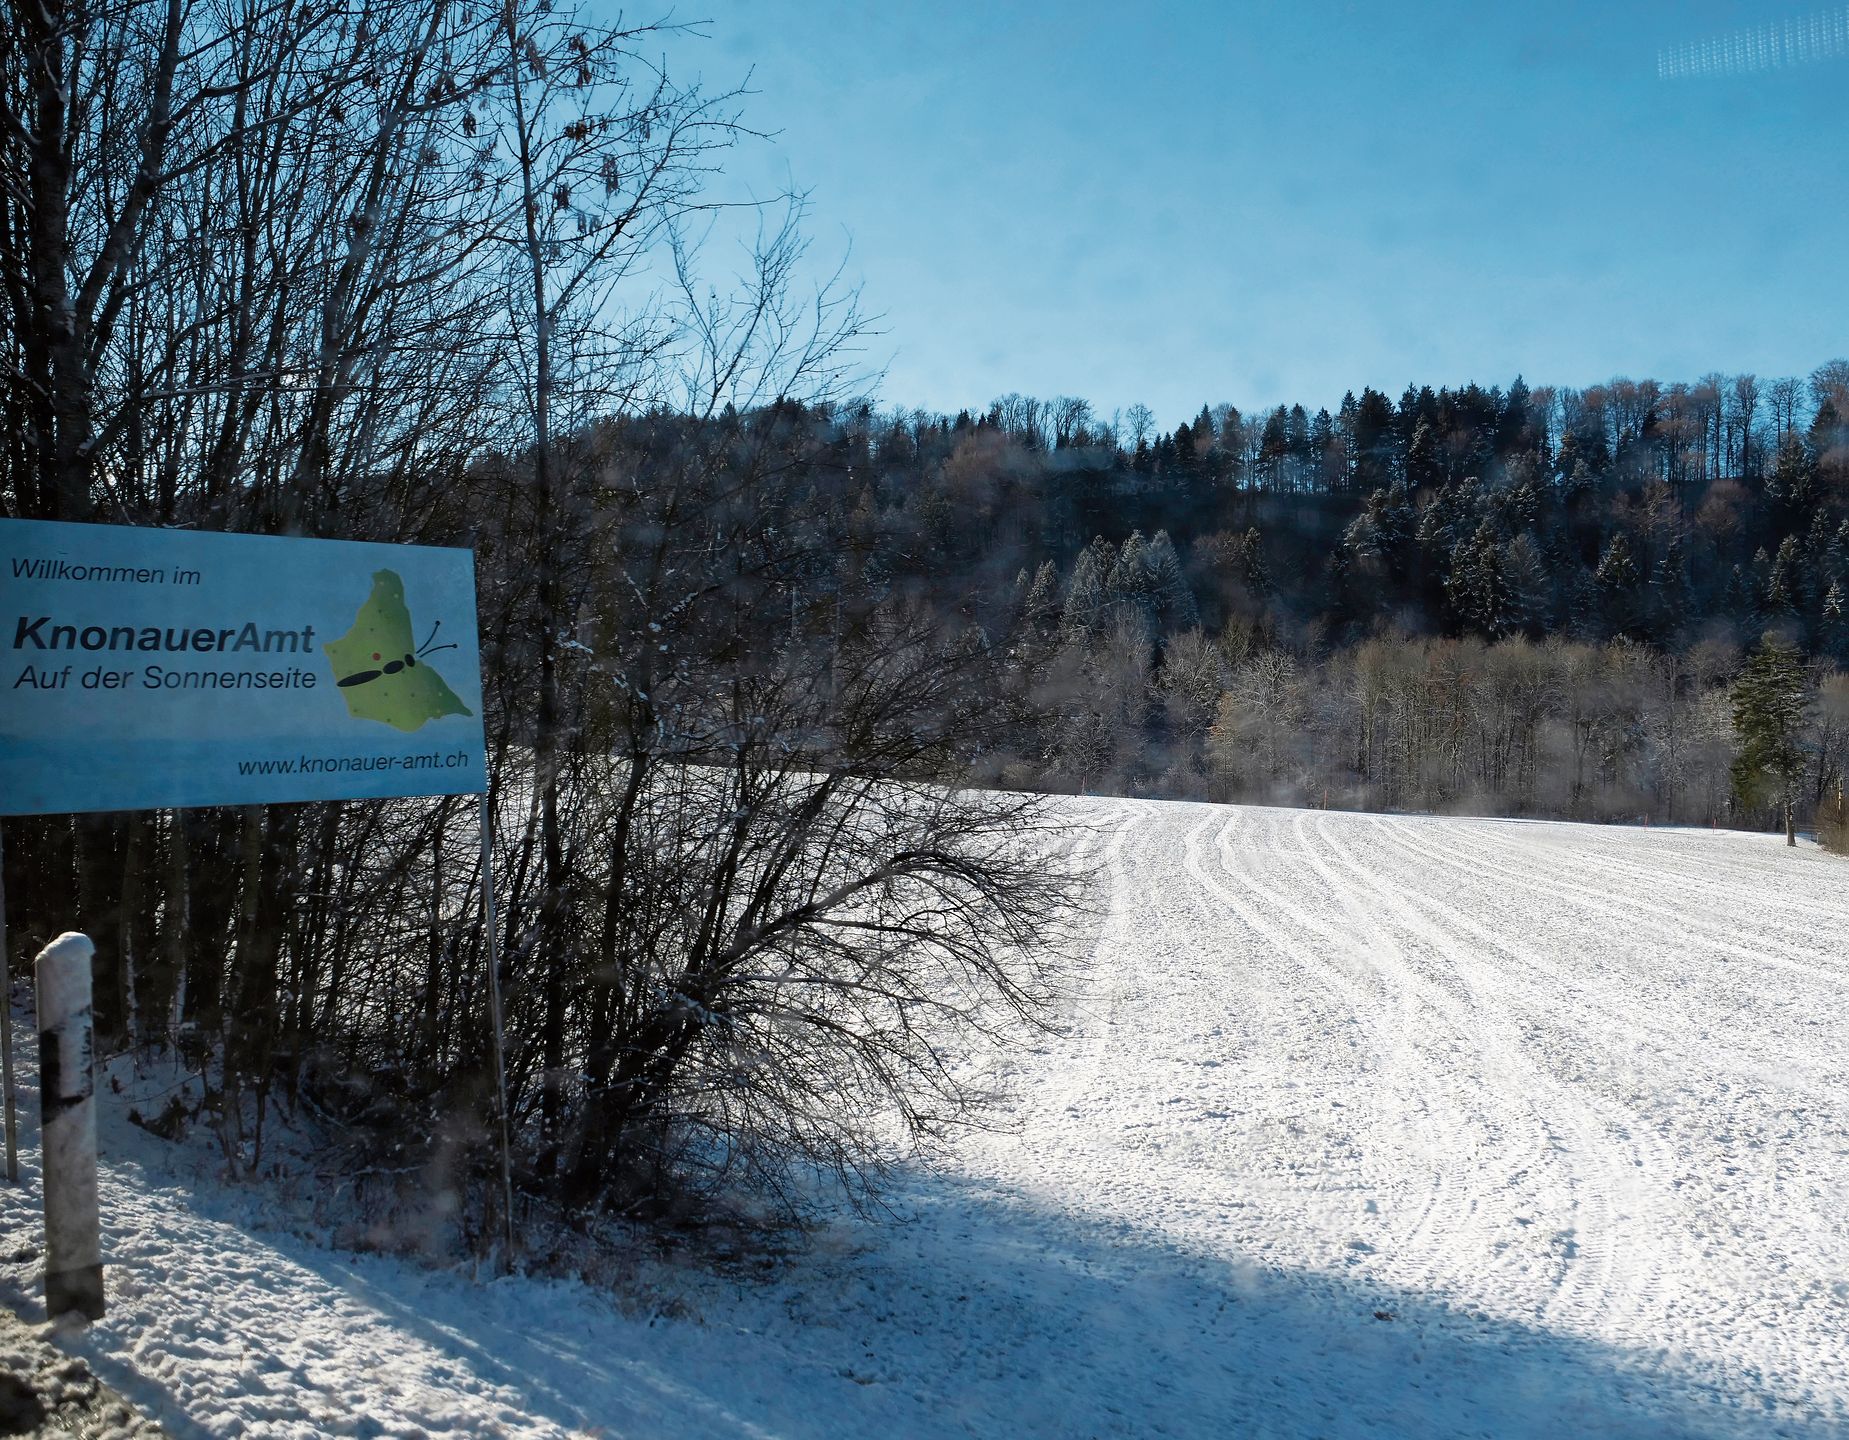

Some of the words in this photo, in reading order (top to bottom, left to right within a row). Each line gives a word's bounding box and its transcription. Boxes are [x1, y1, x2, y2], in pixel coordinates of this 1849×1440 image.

[12, 557, 164, 584] Willkommen
[173, 565, 201, 585] im
[13, 616, 315, 653] KnonauerAmt
[13, 664, 73, 689] Auf
[81, 665, 134, 690] der
[143, 664, 316, 689] Sonnenseite
[238, 750, 468, 776] www.knonauer-amt.ch
